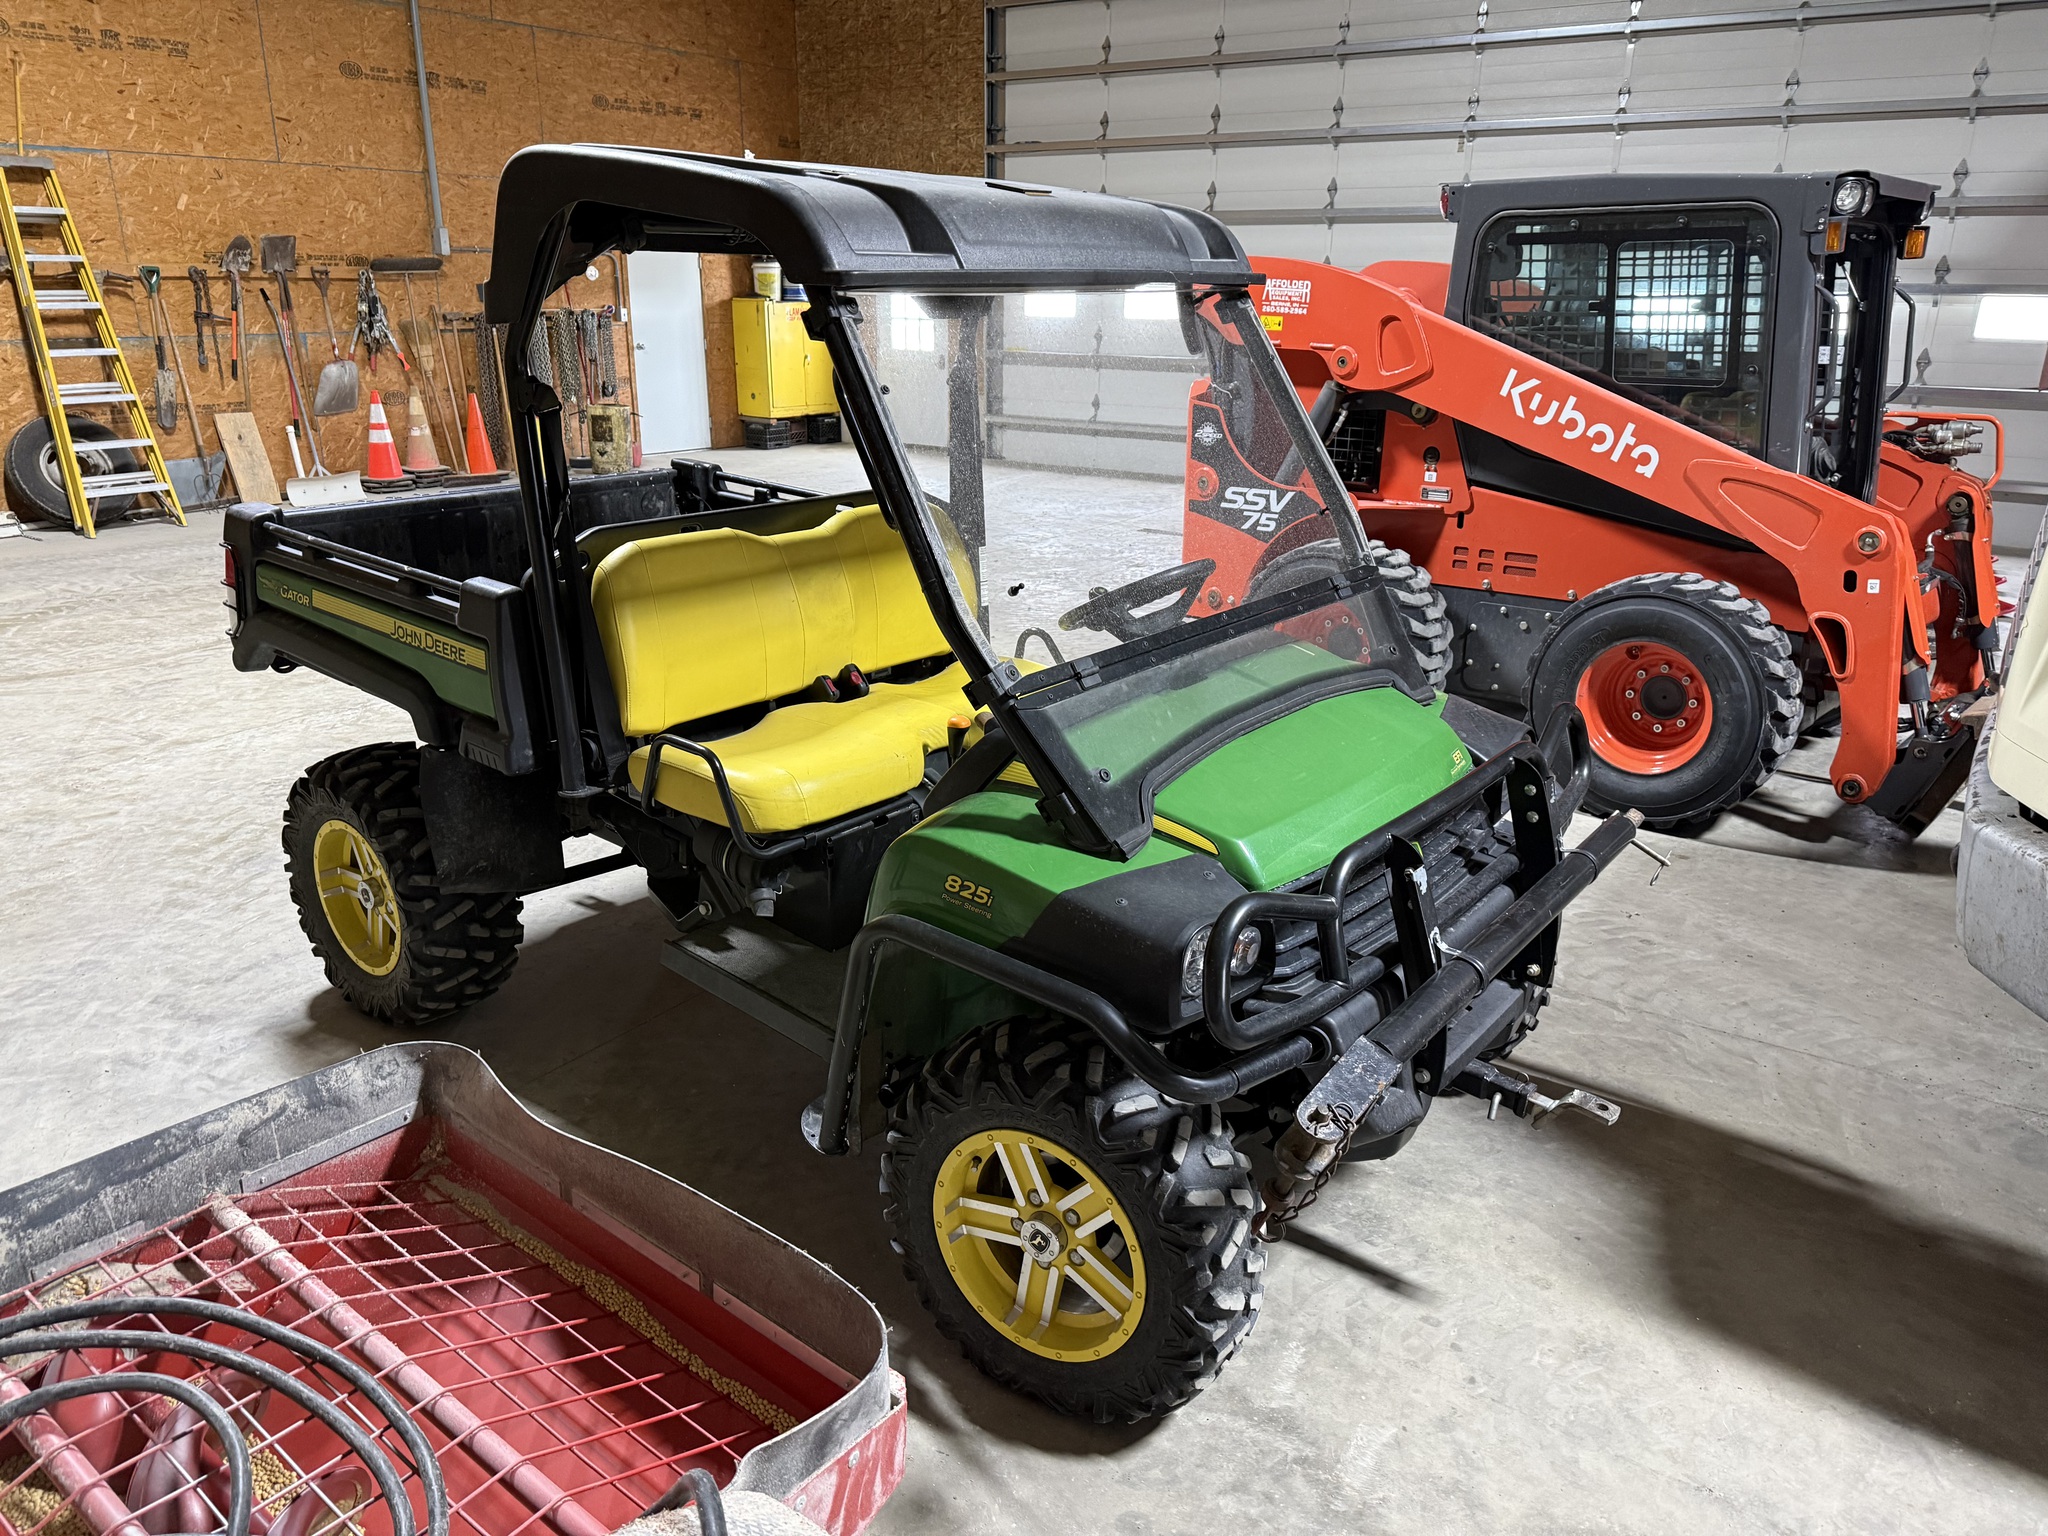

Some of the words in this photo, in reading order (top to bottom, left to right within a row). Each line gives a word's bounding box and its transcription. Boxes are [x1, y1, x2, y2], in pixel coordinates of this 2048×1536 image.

[1262, 278, 1311, 303] AFFOLDER
[1271, 289, 1303, 297] EQUIPMENT
[1262, 305, 1308, 315] 260-589-2964
[1500, 368, 1660, 479] Kubota
[1220, 486, 1296, 513] SSV
[1241, 511, 1279, 532] 75
[280, 586, 310, 607] GATOR
[390, 621, 423, 649] JOHN
[424, 634, 468, 663] DEERE
[944, 875, 994, 908] 825i
[942, 893, 962, 906] Power
[963, 902, 992, 919] Steering
